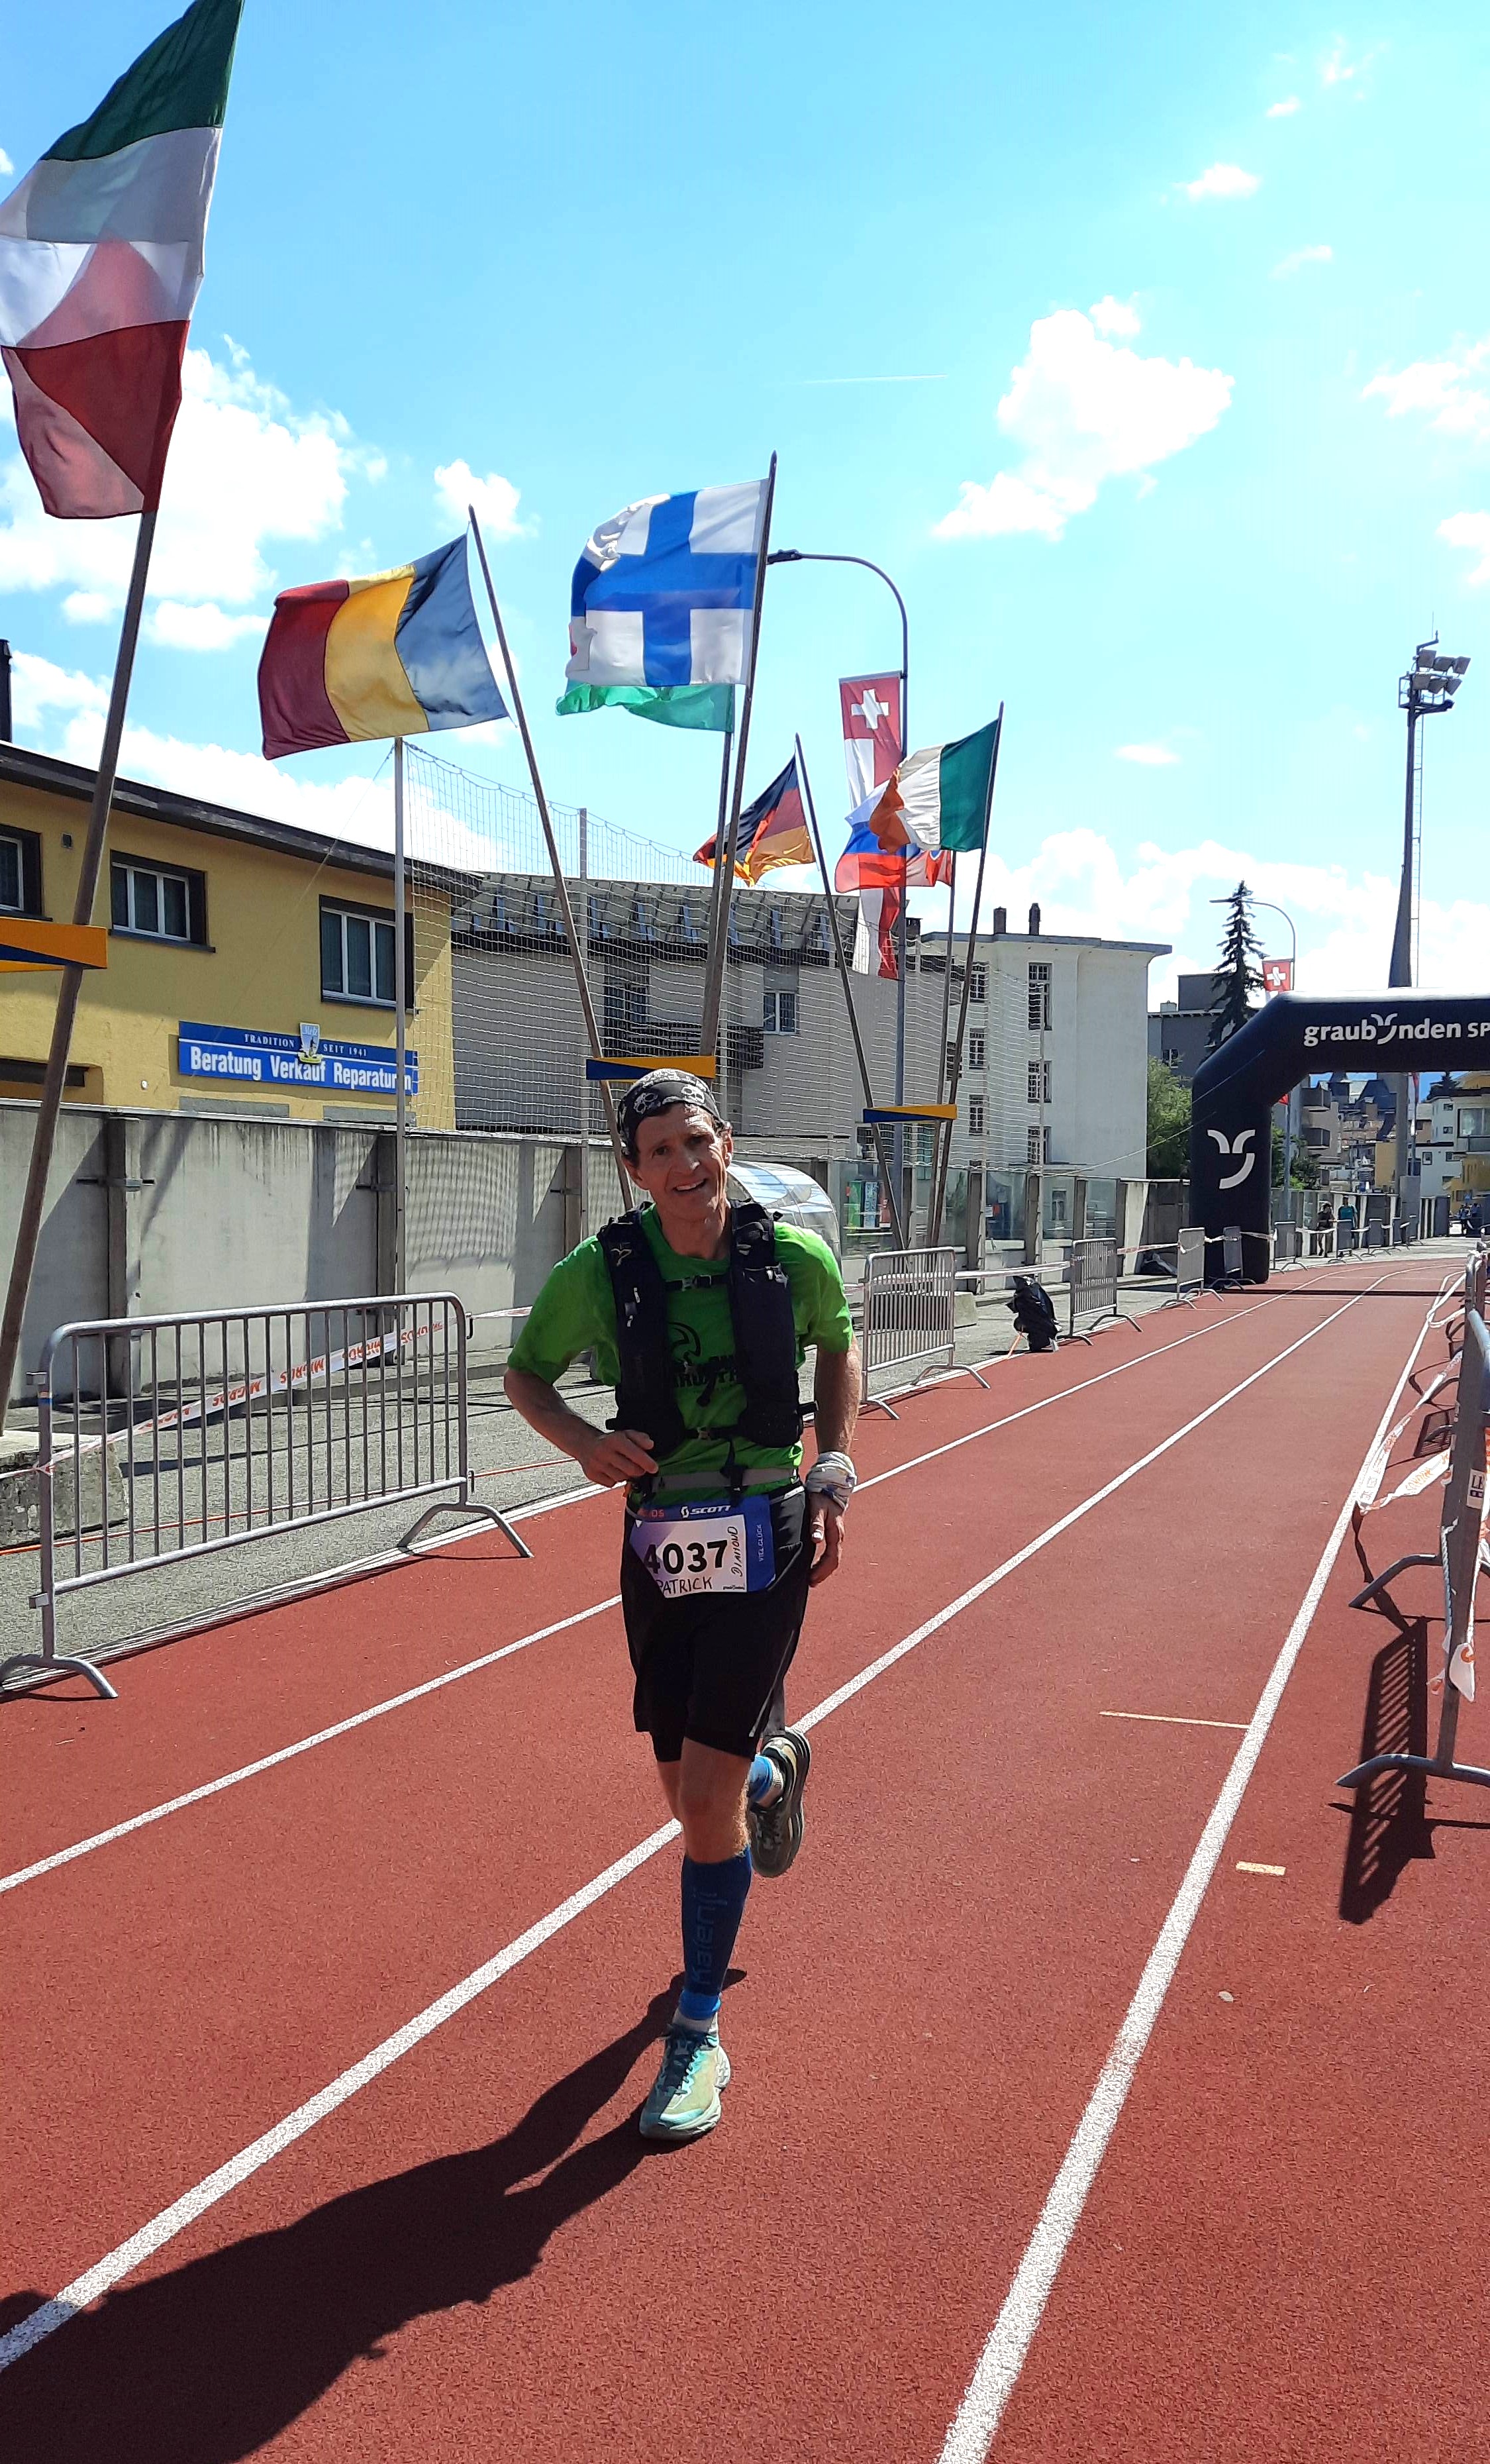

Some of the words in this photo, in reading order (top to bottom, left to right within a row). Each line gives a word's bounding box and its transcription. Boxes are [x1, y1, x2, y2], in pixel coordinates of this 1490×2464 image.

[244, 1033, 295, 1048] TRADITION
[323, 1043, 344, 1054] SEIT
[349, 1047, 367, 1057] 1941
[190, 1046, 262, 1081] Beratung
[270, 1054, 326, 1082] Verkauf
[333, 1062, 411, 1091] Reparaturn
[689, 1505, 731, 1515] SCOTT
[643, 1539, 728, 1574] 4037
